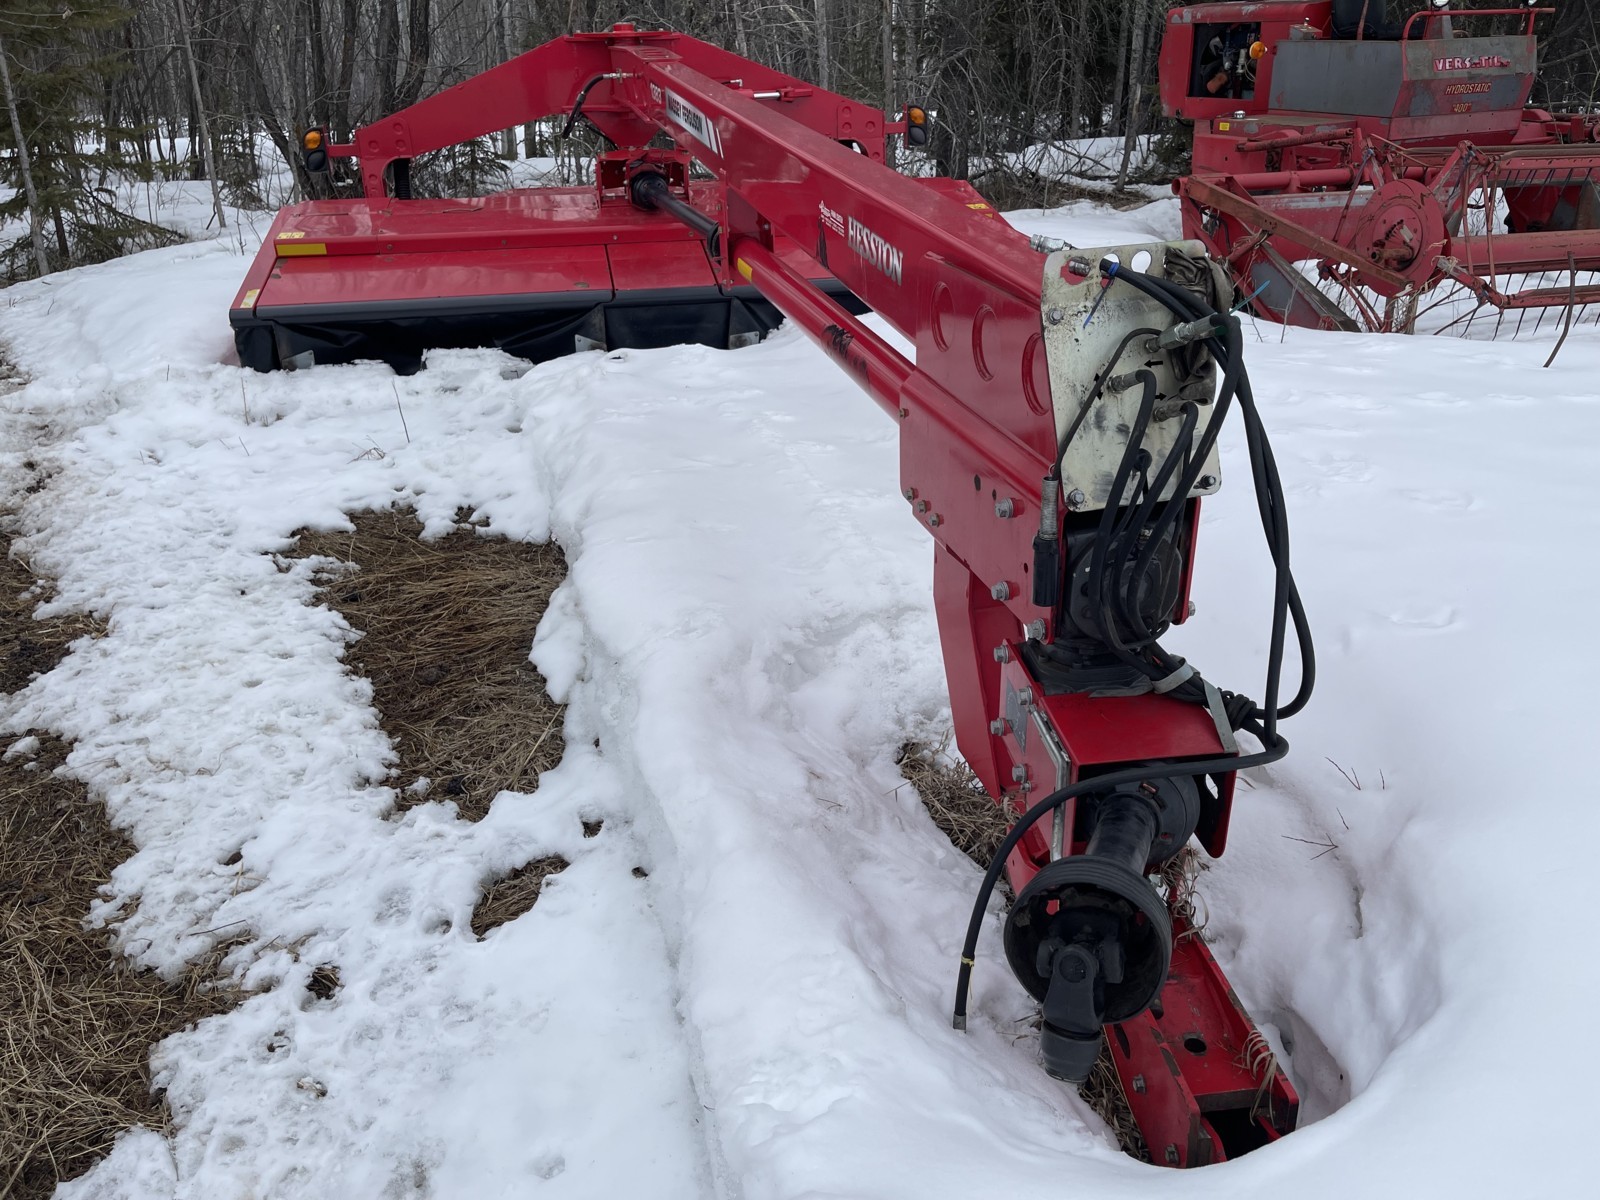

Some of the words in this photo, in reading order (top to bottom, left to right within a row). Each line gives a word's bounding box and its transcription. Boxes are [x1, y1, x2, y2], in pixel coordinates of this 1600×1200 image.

[1434, 55, 1511, 73] VERSTIL
[1445, 82, 1492, 95] HYDROSTATIC
[667, 93, 682, 119] MASSEY
[681, 103, 703, 135] FERGUSON
[848, 215, 904, 288] HESSTON
